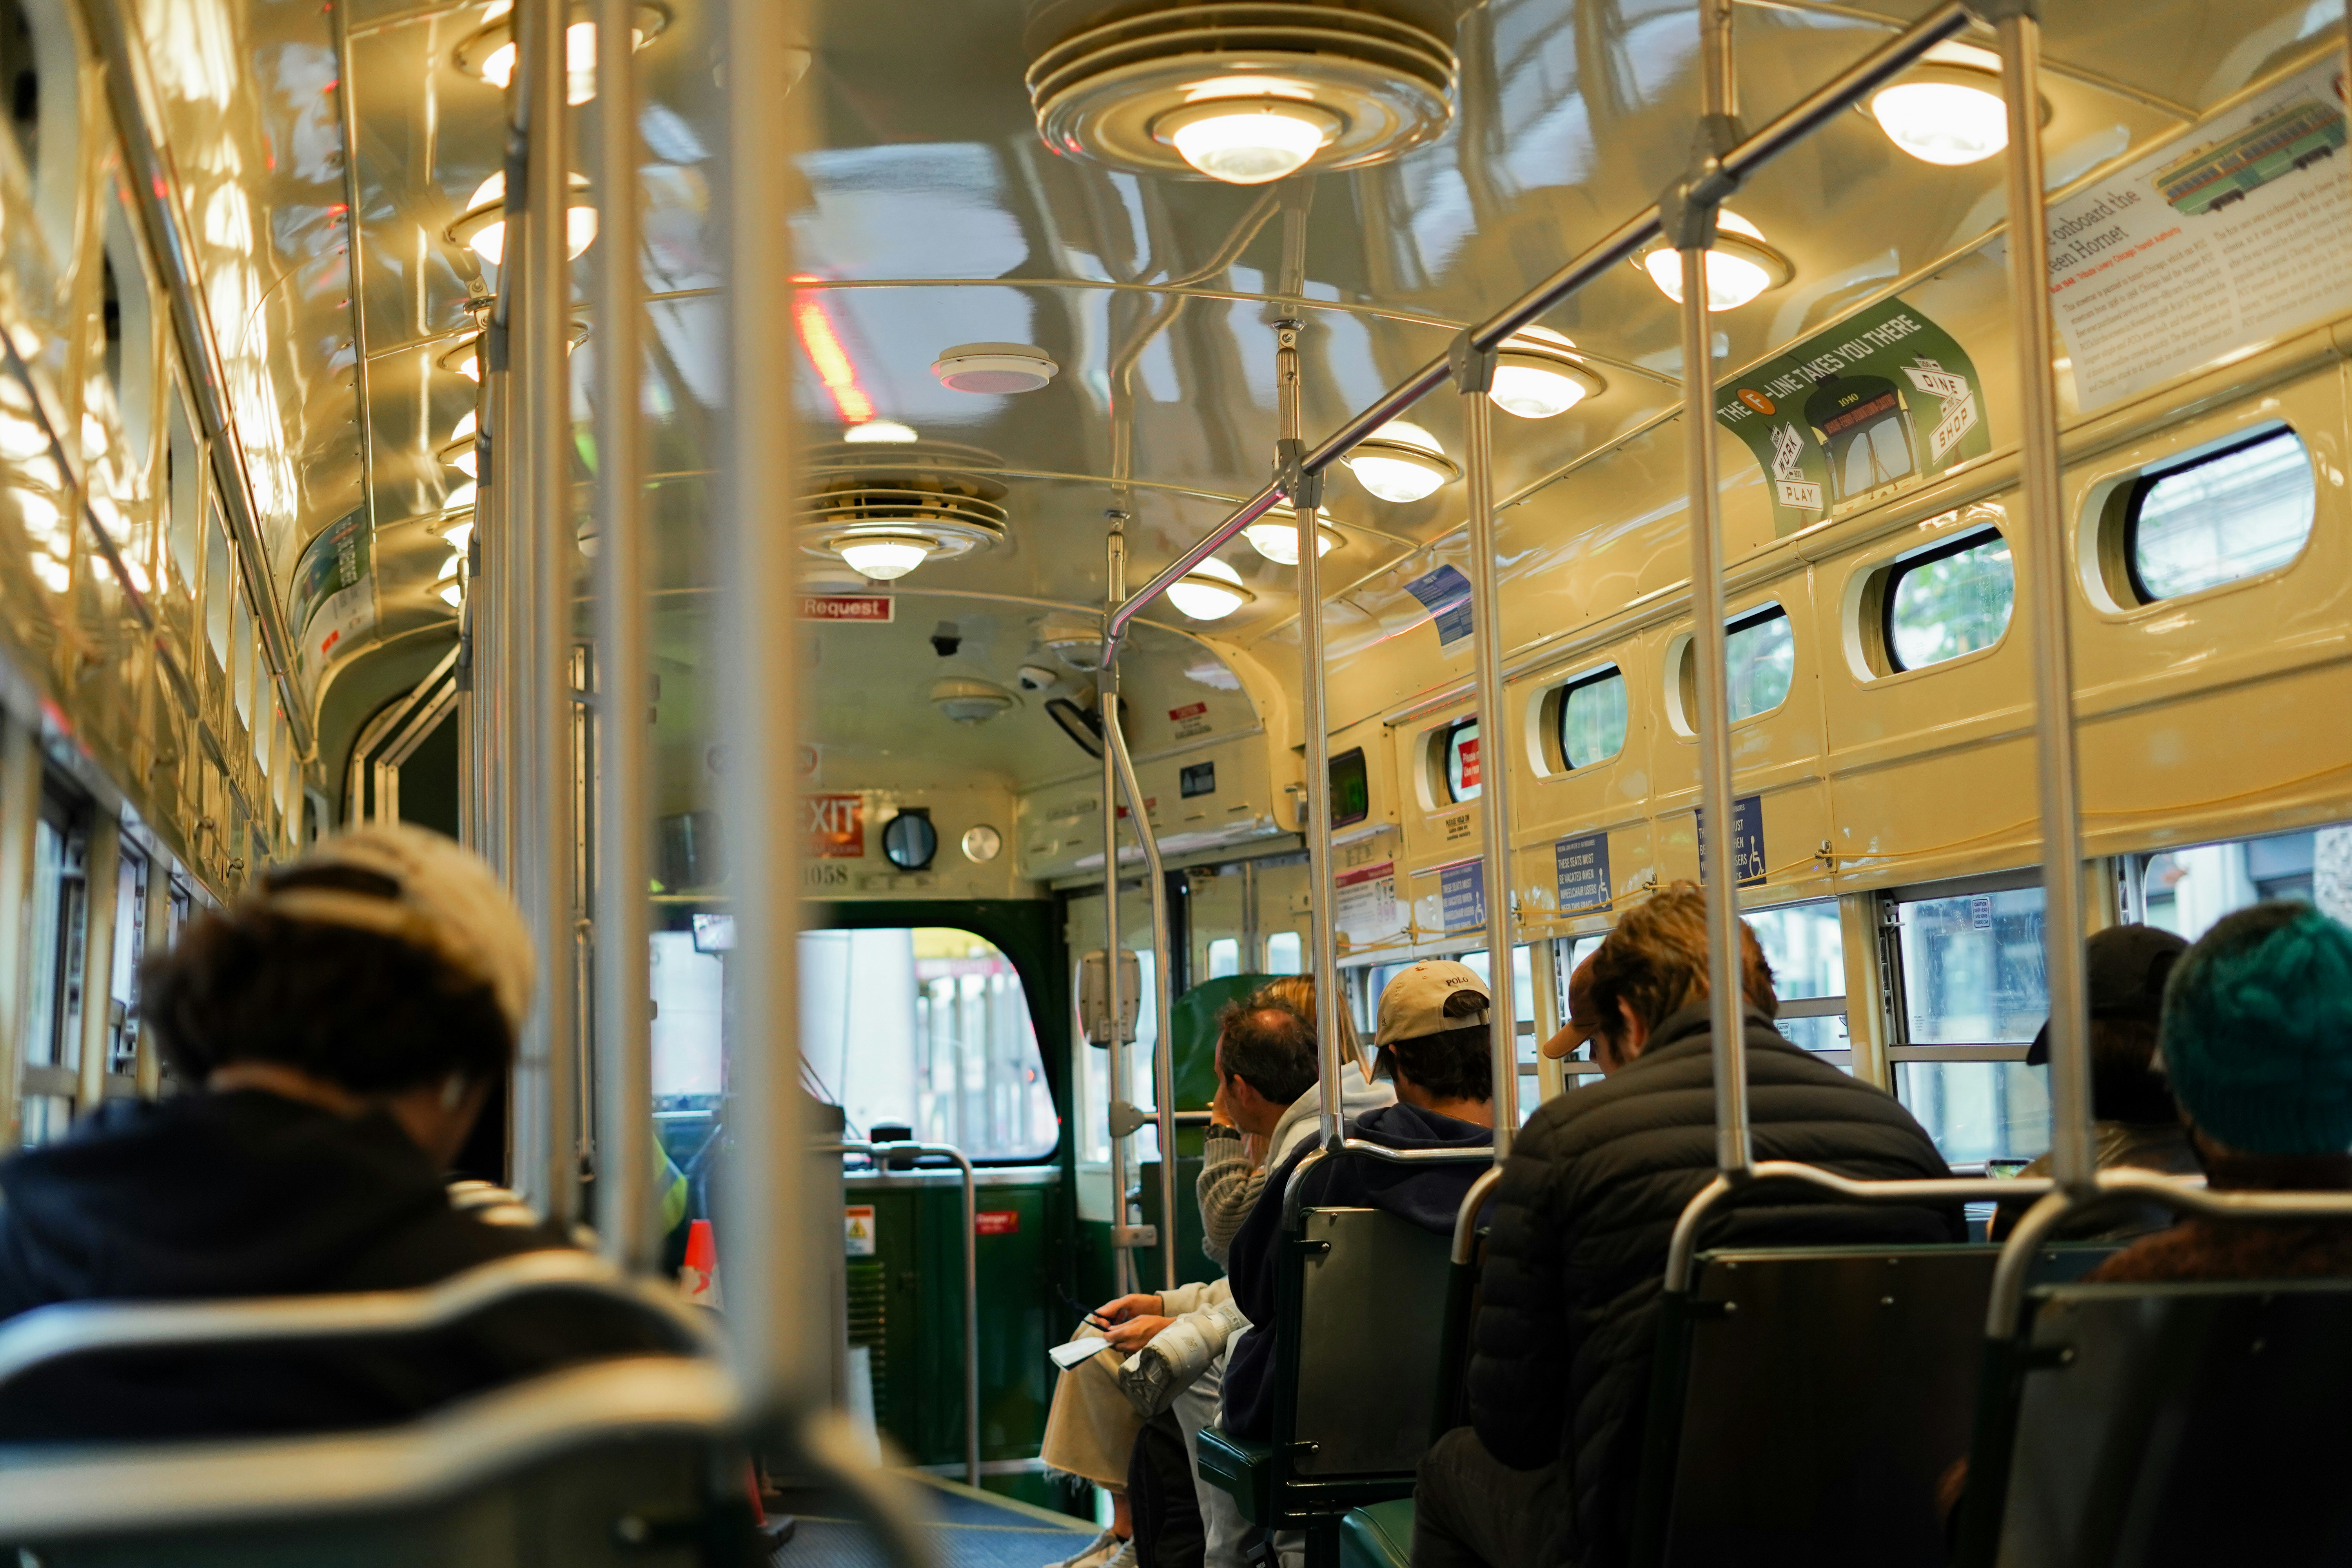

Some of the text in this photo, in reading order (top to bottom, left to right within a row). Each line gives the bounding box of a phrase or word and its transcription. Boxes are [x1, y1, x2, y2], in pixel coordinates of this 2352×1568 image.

[2053, 191, 2141, 240] onboard the
[2047, 225, 2129, 275] reen Hornet
[2113, 249, 2136, 263] Chicago
[1716, 401, 1752, 422] THE
[1746, 394, 1765, 409] F
[1791, 354, 1845, 384] TAKES
[1833, 338, 1875, 362] YOU
[1864, 314, 1922, 347] THERE
[1922, 374, 1958, 394] DINE
[1838, 393, 1858, 407] 1040
[1939, 407, 1967, 448] SHOP
[1779, 435, 1797, 474] WORK
[1786, 486, 1813, 502] PLAY
[804, 598, 879, 617] Request
[1733, 804, 1745, 812] EQUIRES
[1734, 819, 1744, 832] UST
[1734, 837, 1744, 849] HEN
[1558, 853, 1593, 869] THESE SEATS MUST
[1735, 853, 1747, 866] SERS
[1559, 869, 1594, 884] BE VACATED WHEN
[1560, 884, 1597, 899] WHEELCHAIR USERS
[1446, 977, 1468, 986] POLO
